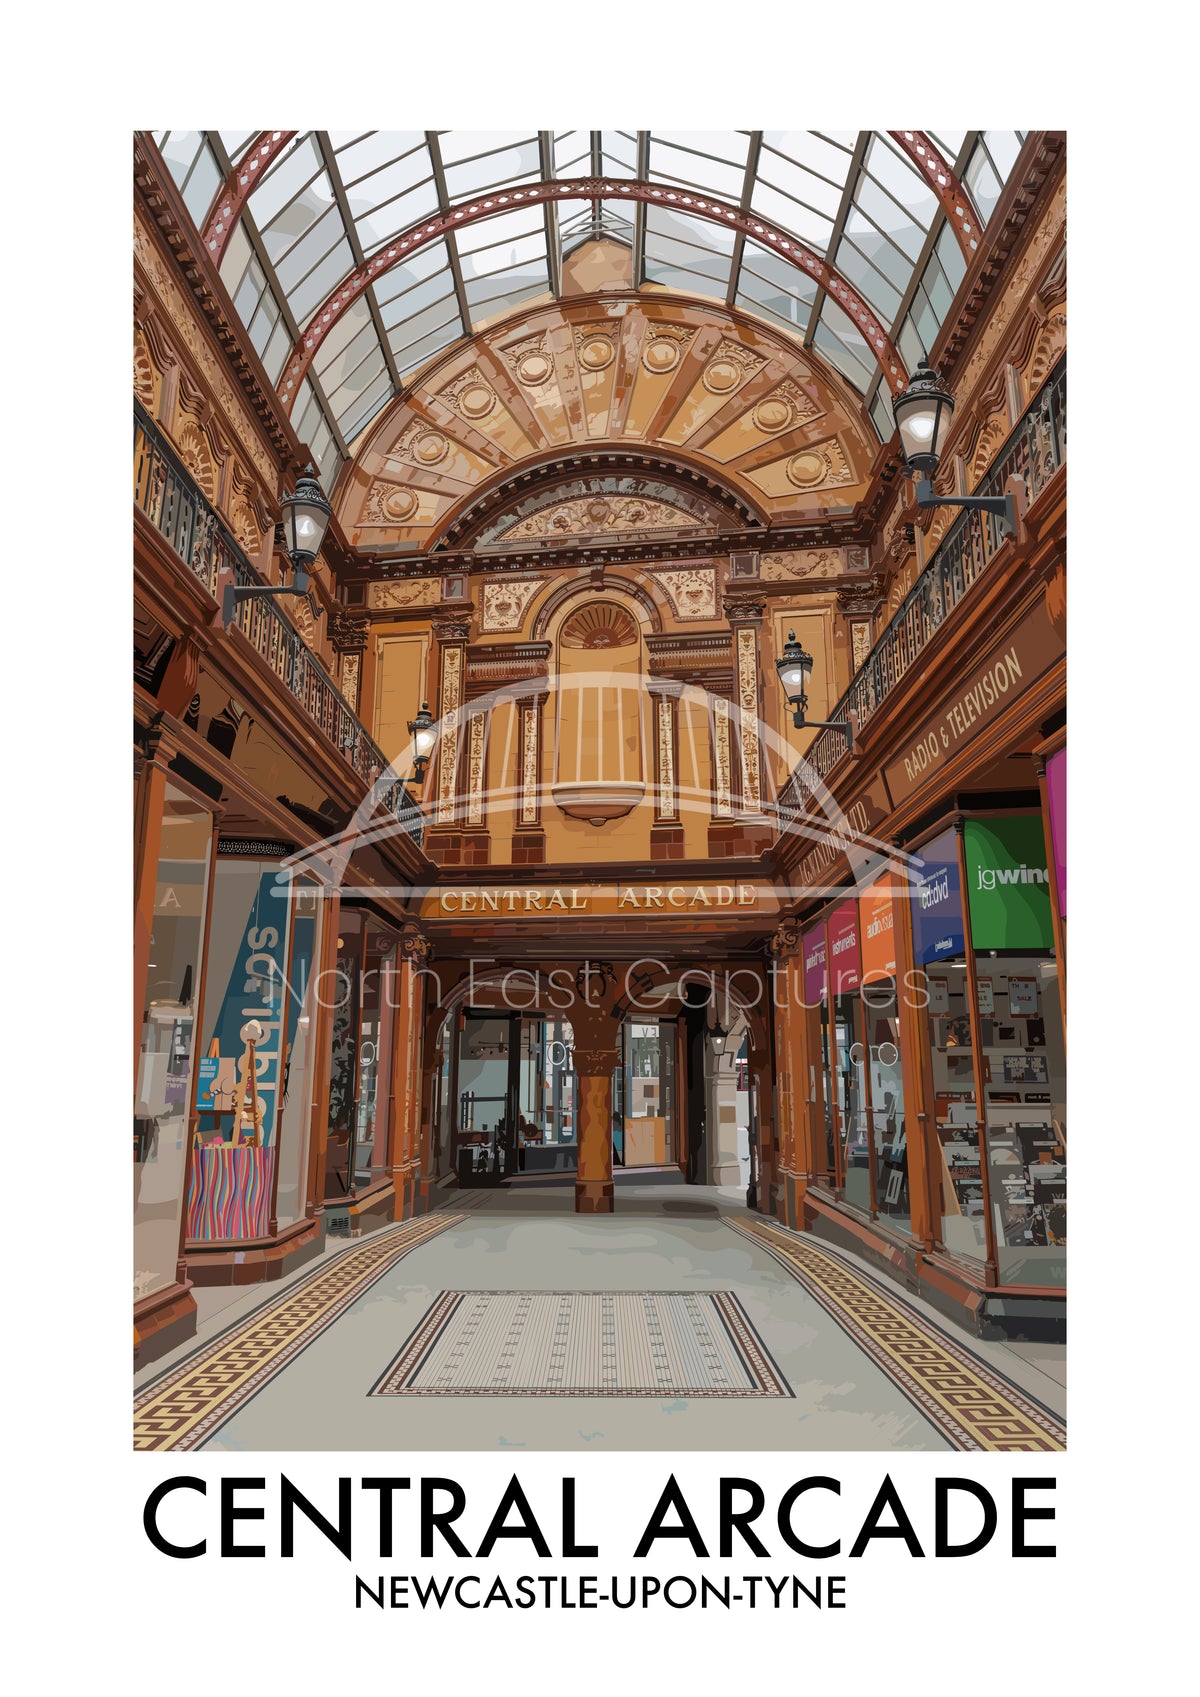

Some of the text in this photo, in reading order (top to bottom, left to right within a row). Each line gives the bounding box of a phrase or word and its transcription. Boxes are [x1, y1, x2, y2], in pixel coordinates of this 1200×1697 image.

[904, 647, 1023, 781] RADIO & TELEVISION
[441, 884, 755, 912] CENTRAL ARCADE
